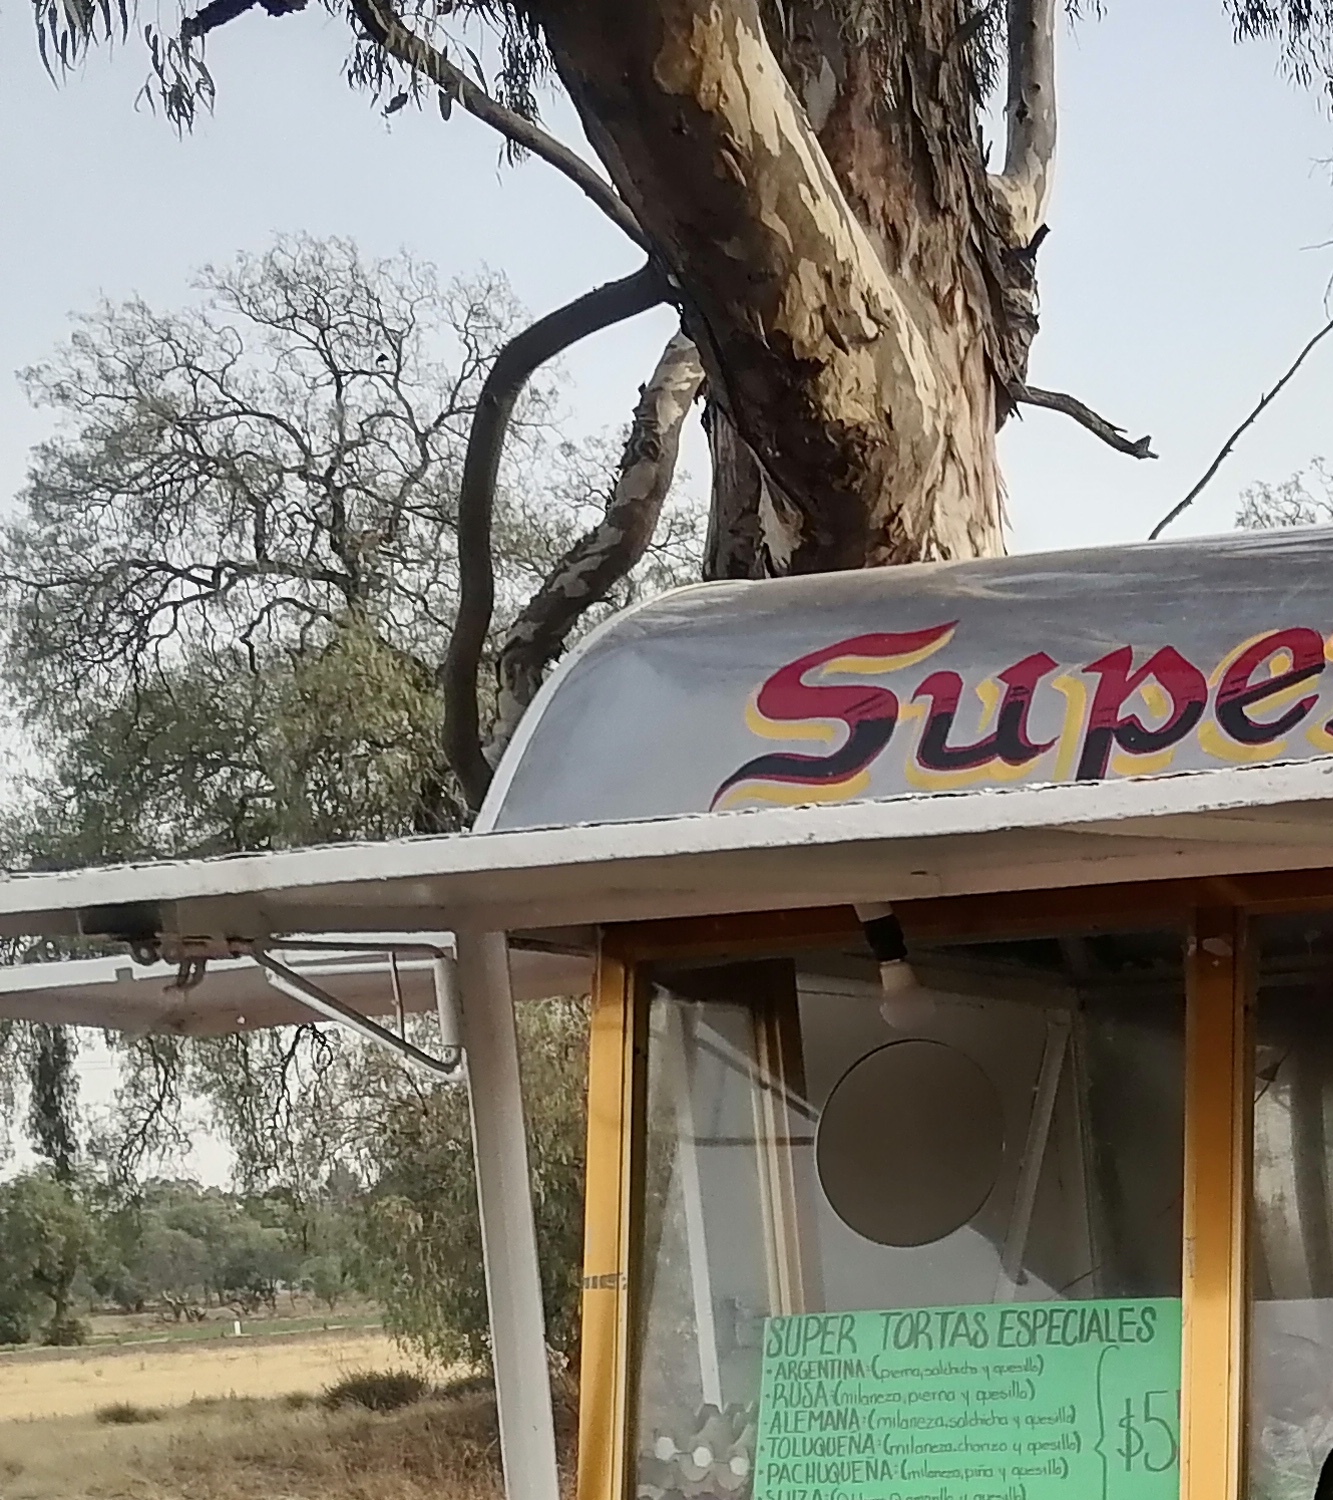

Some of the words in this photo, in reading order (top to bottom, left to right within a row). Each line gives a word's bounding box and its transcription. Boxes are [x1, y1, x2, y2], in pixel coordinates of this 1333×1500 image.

[766, 1314, 857, 1358] SUPER
[879, 1310, 988, 1351] TORTAS
[996, 1306, 1157, 1348] ESPECIALES
[982, 1365, 991, 1381] y
[960, 1390, 970, 1407] y
[1012, 1417, 1021, 1430] y
[1116, 1389, 1180, 1472] $5
[1012, 1442, 1021, 1457] y
[998, 1467, 1007, 1483] y
